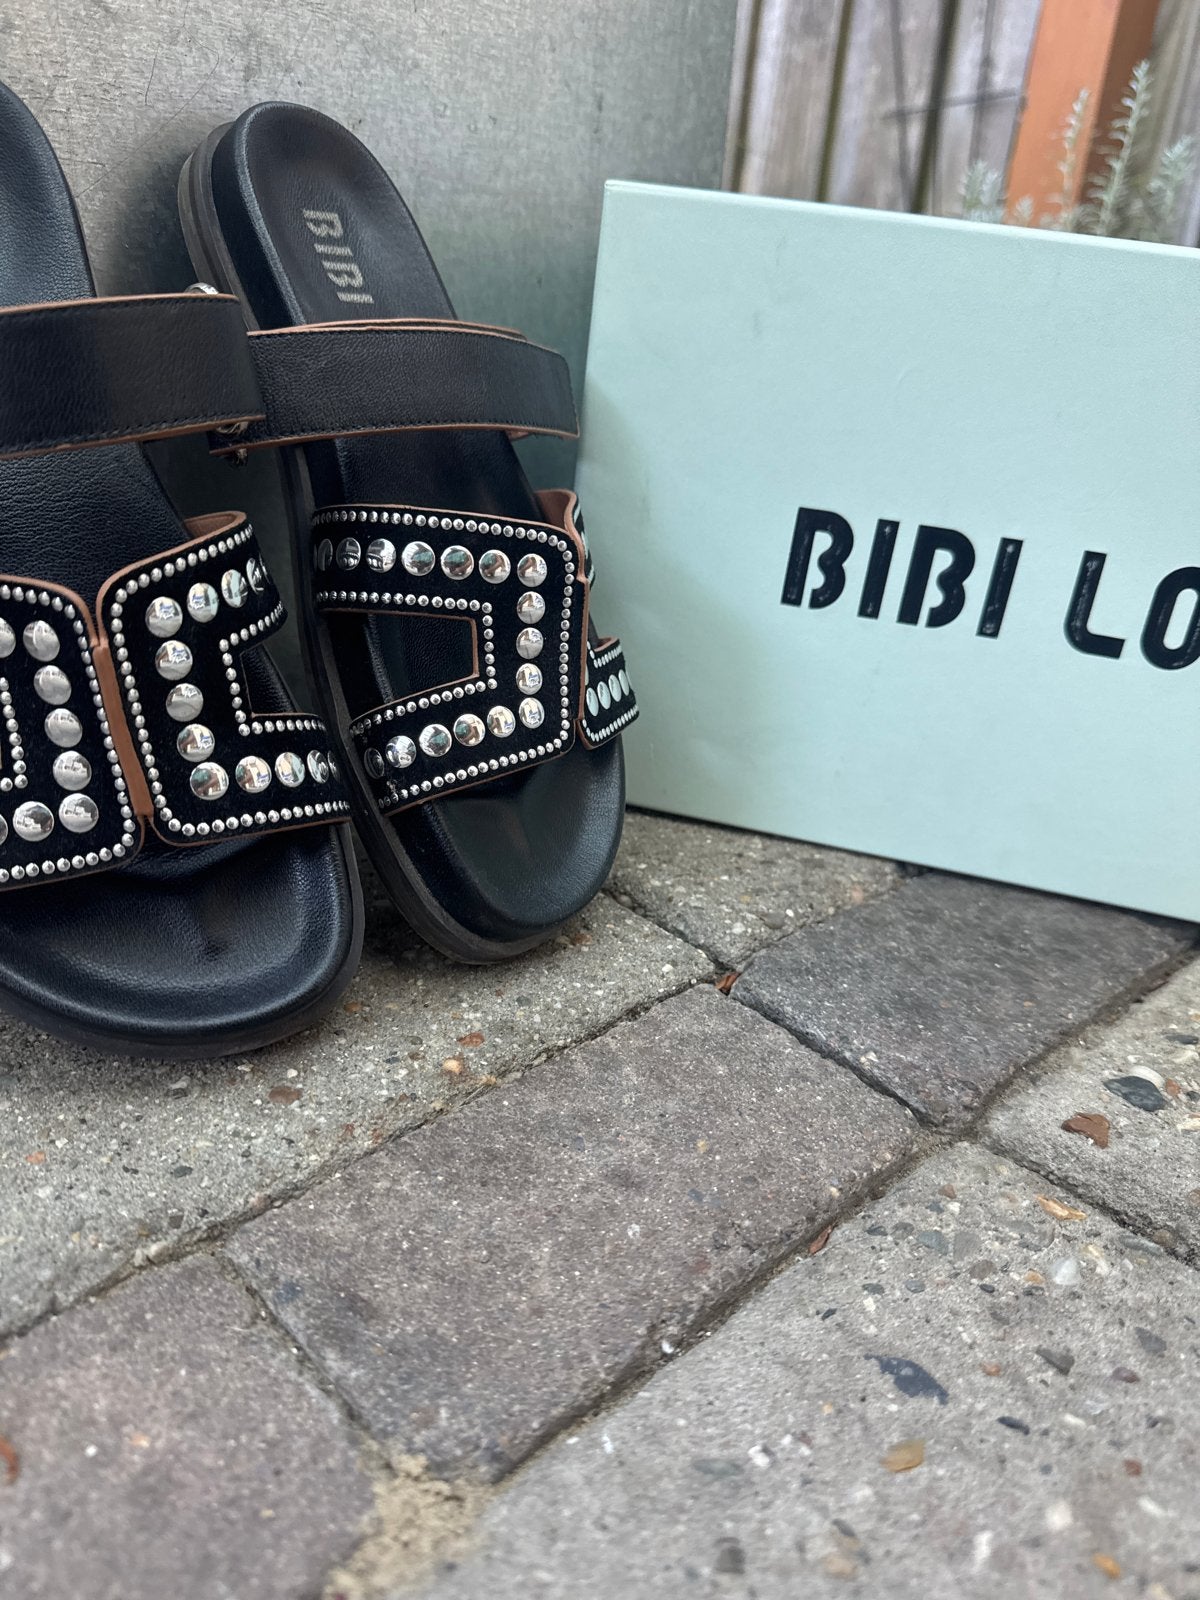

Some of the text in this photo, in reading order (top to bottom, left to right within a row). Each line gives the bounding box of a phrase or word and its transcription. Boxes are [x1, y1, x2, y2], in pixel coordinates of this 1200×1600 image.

[302, 208, 374, 304] BIBI
[780, 506, 1200, 670] BIBI LO
